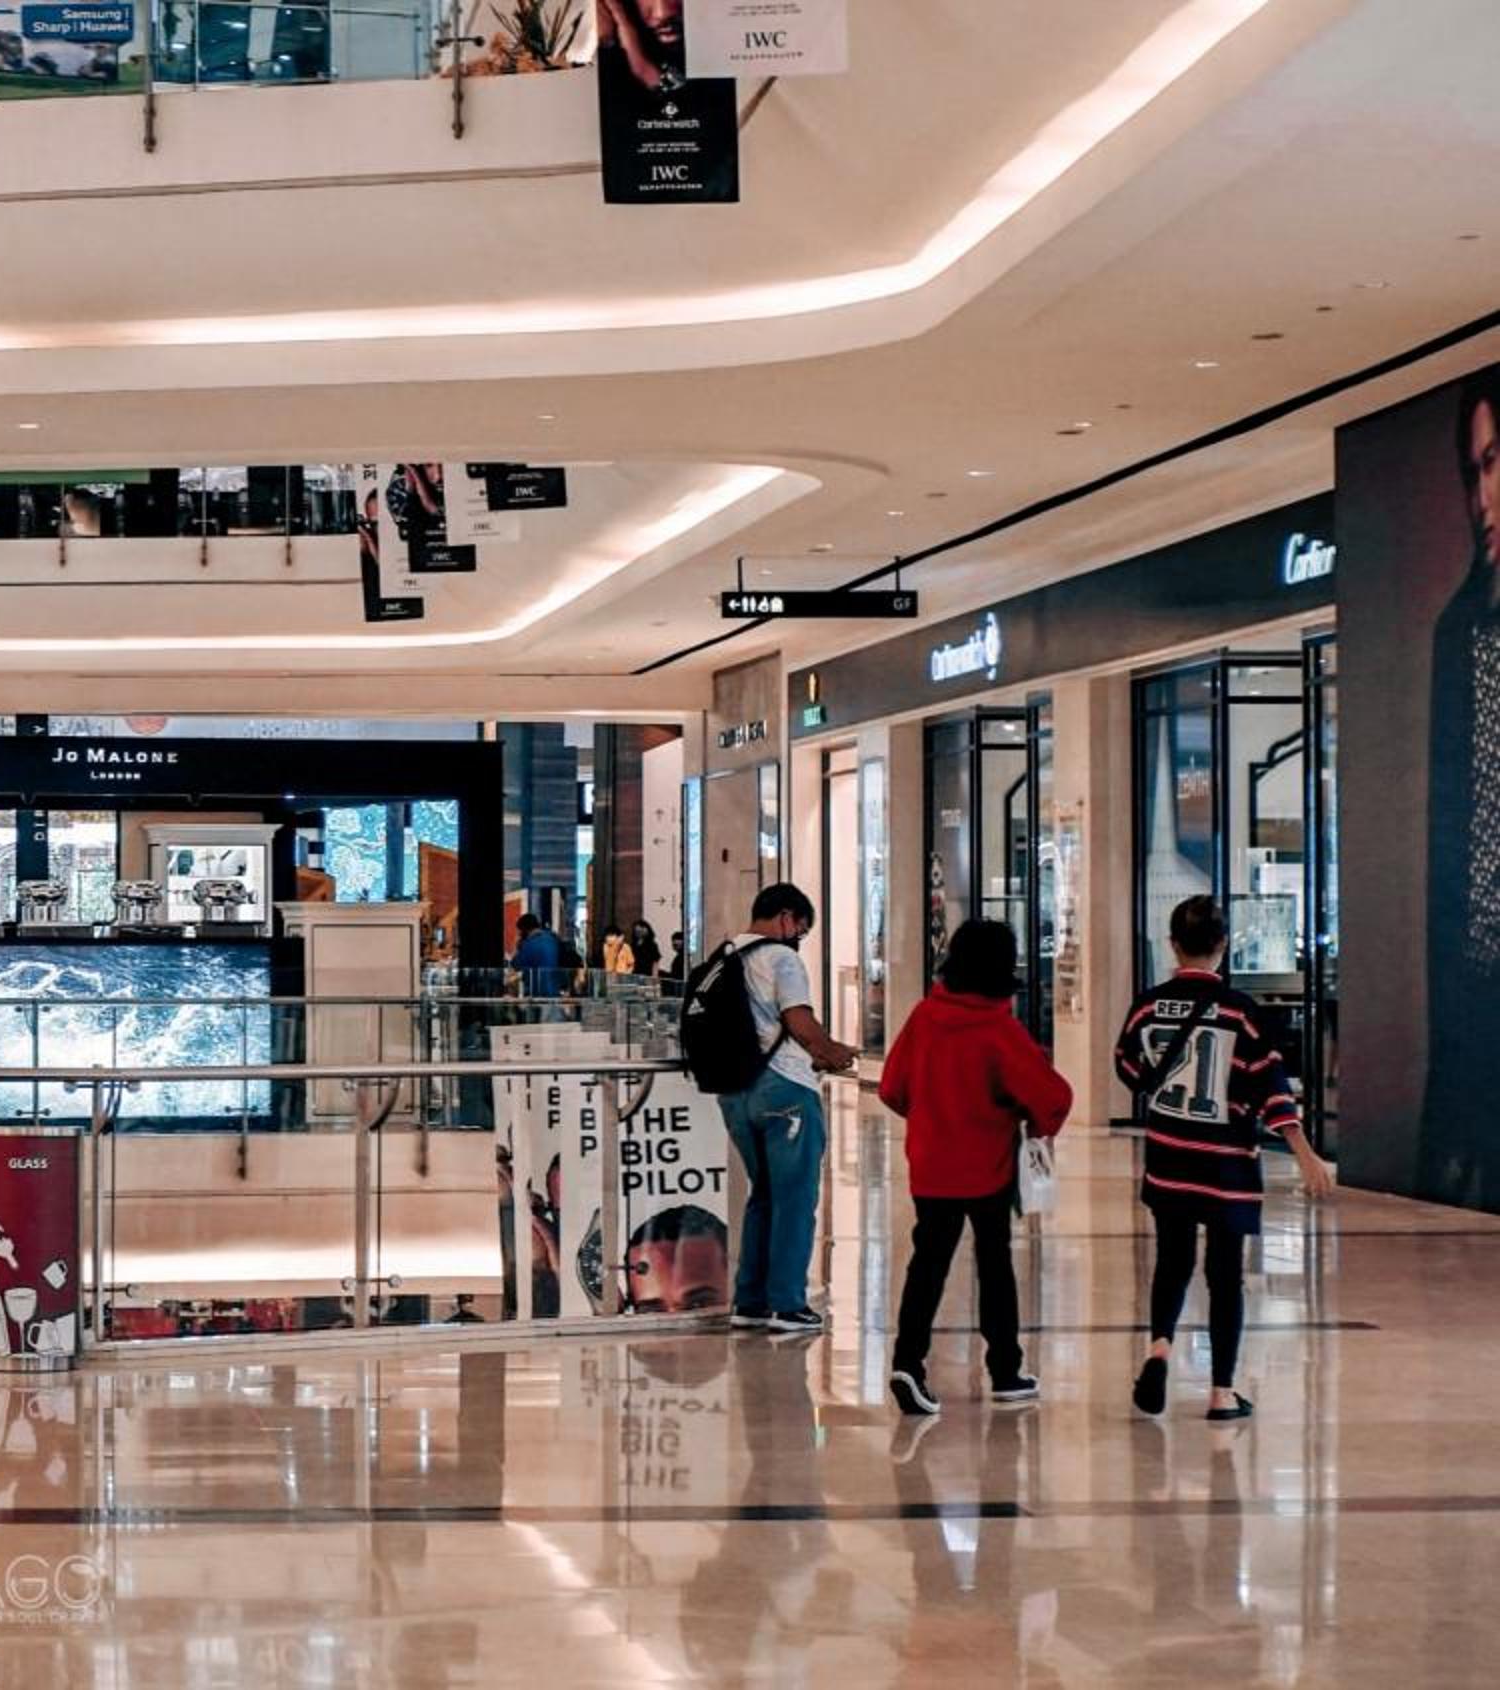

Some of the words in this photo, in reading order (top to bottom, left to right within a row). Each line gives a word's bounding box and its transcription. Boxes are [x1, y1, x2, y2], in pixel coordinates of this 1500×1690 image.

[62, 8, 121, 20] Samsung
[33, 21, 70, 34] Sharp
[79, 21, 129, 31] Huawei
[745, 30, 787, 48] IWC
[652, 165, 689, 180] IWC
[620, 1138, 680, 1165] BIG
[8, 1157, 48, 1169] GLASS
[622, 1167, 727, 1197] PILOT
